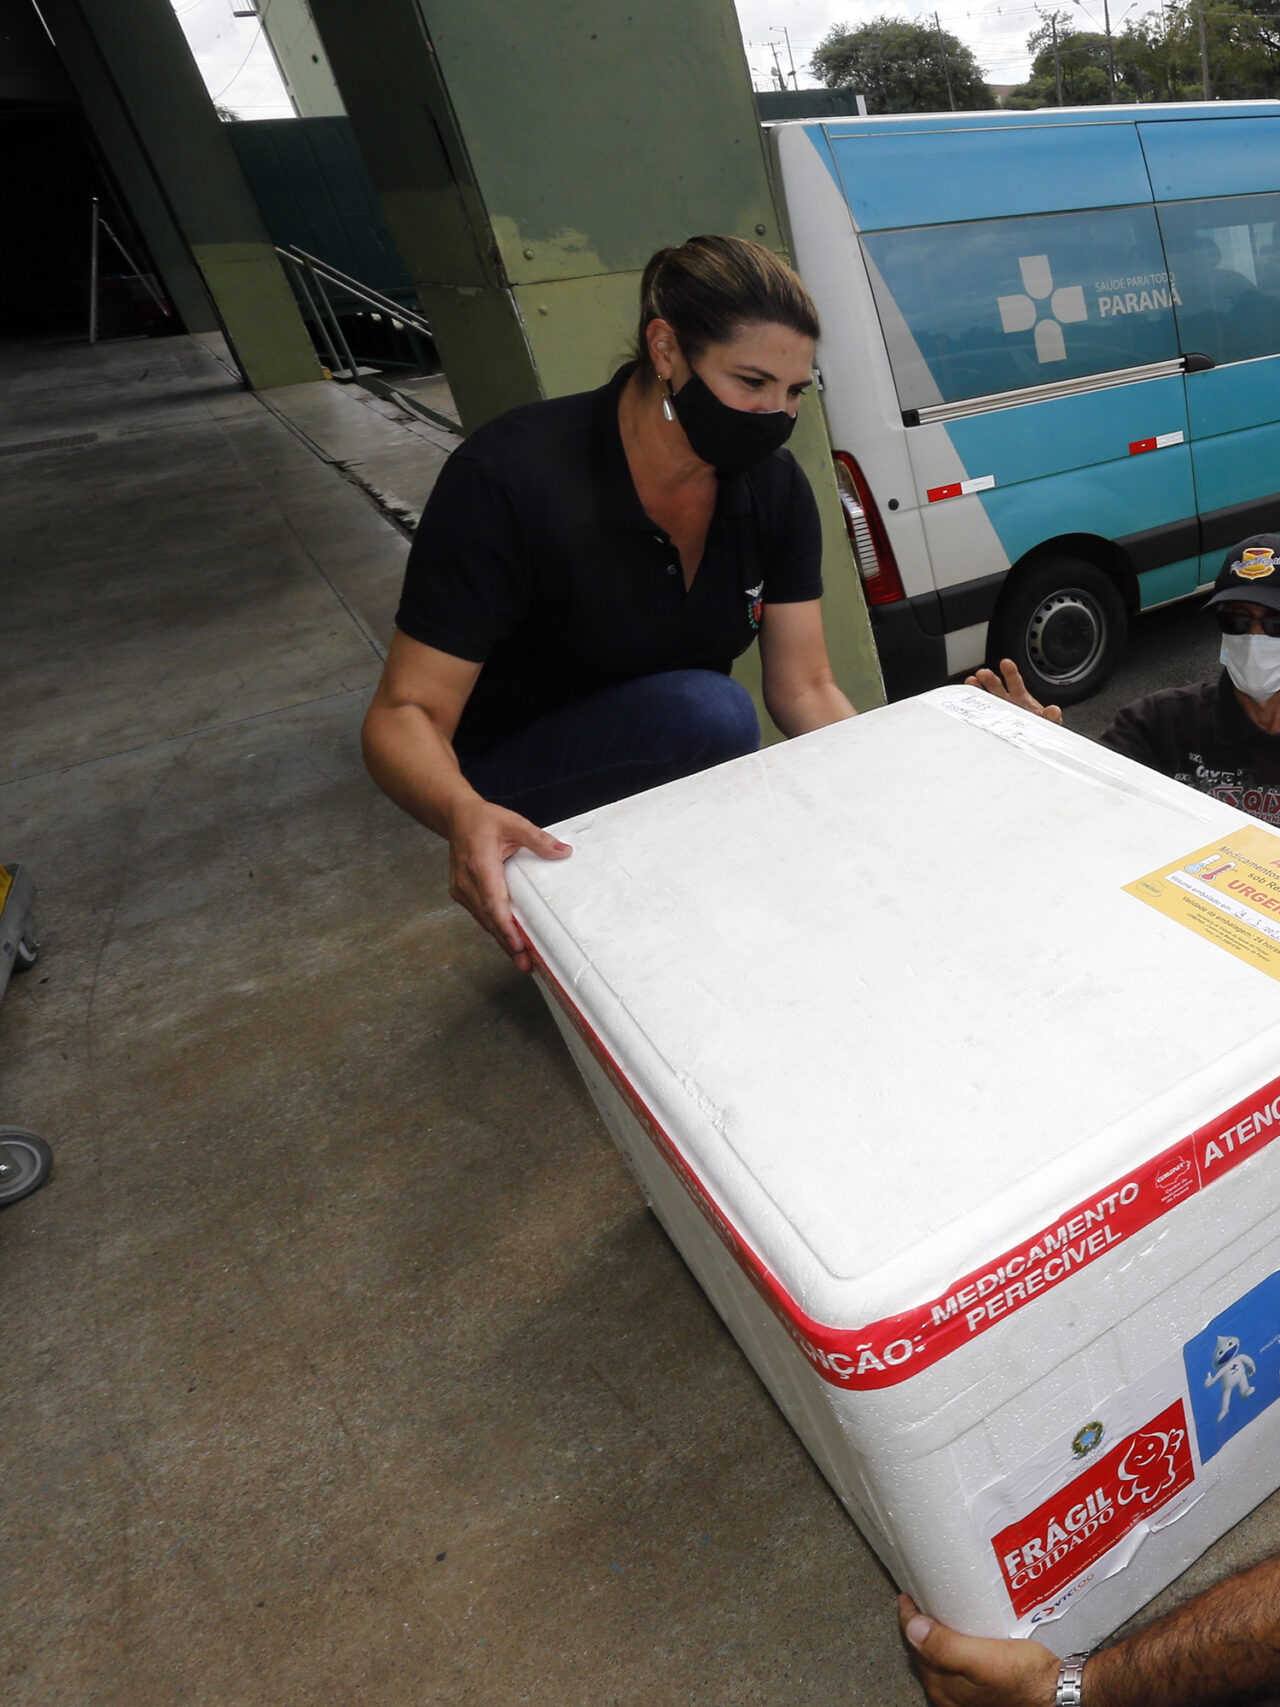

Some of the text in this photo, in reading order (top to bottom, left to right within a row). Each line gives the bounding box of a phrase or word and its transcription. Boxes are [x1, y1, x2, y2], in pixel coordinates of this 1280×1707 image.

[1127, 275, 1149, 288] PARA
[1098, 282, 1183, 318] PARANÁ
[1169, 875, 1194, 889] Volume
[1190, 887, 1224, 905] embalado
[1246, 872, 1267, 883] sob
[1180, 896, 1209, 912] Validade
[931, 1182, 1139, 1327] MEDICAMENTO
[966, 1222, 1122, 1332] PERECÍVEL
[1004, 1487, 1112, 1578] FRÁGIL
[1011, 1507, 1115, 1590] CUIDADO
